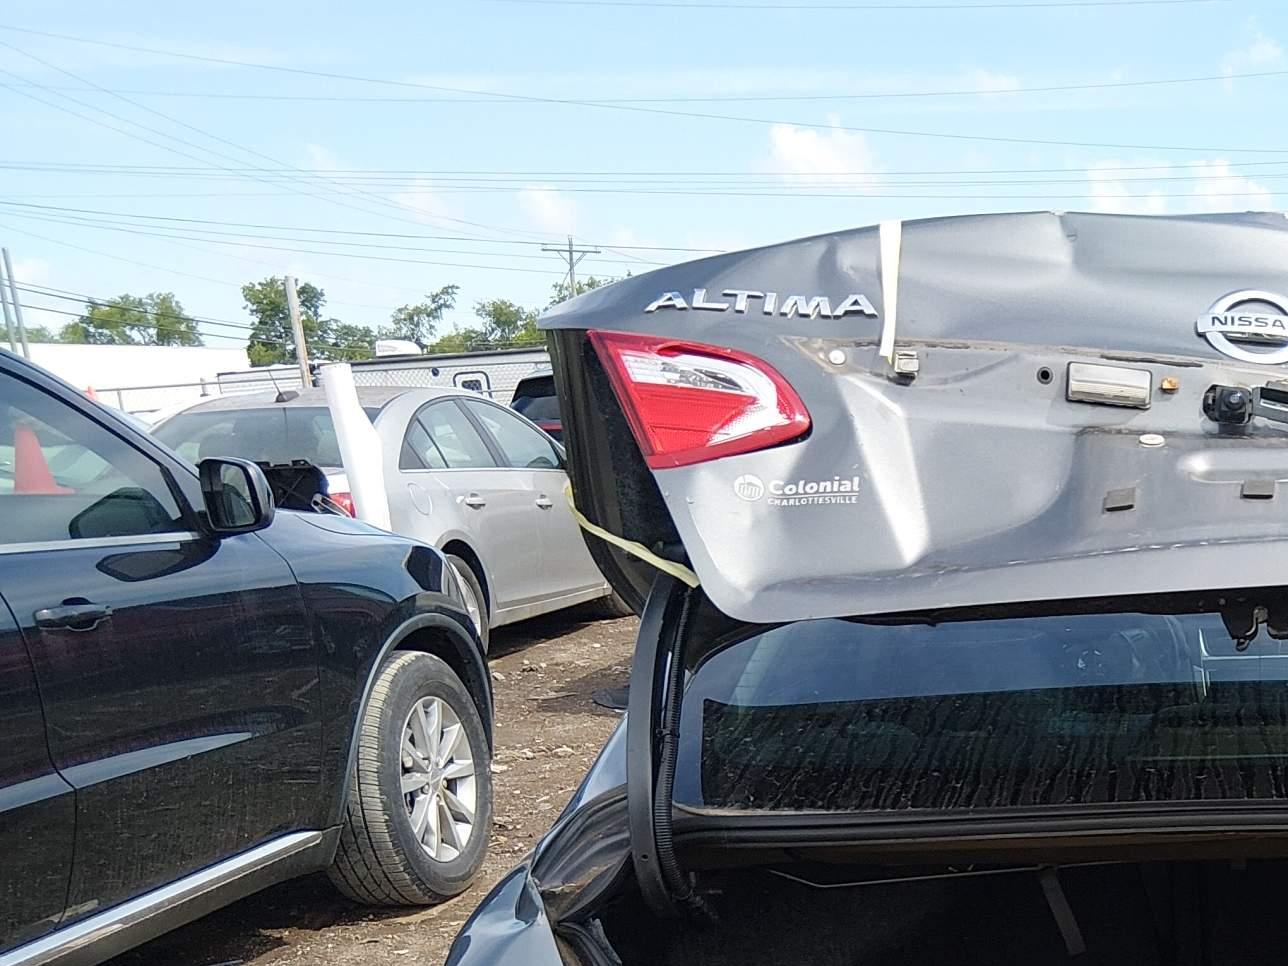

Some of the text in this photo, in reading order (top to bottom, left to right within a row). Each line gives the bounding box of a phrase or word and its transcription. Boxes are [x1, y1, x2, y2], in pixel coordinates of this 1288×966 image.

[644, 288, 879, 320] ALTIMA
[768, 476, 860, 495] Colonial
[767, 495, 859, 506] CHARLOTTESVILLE
